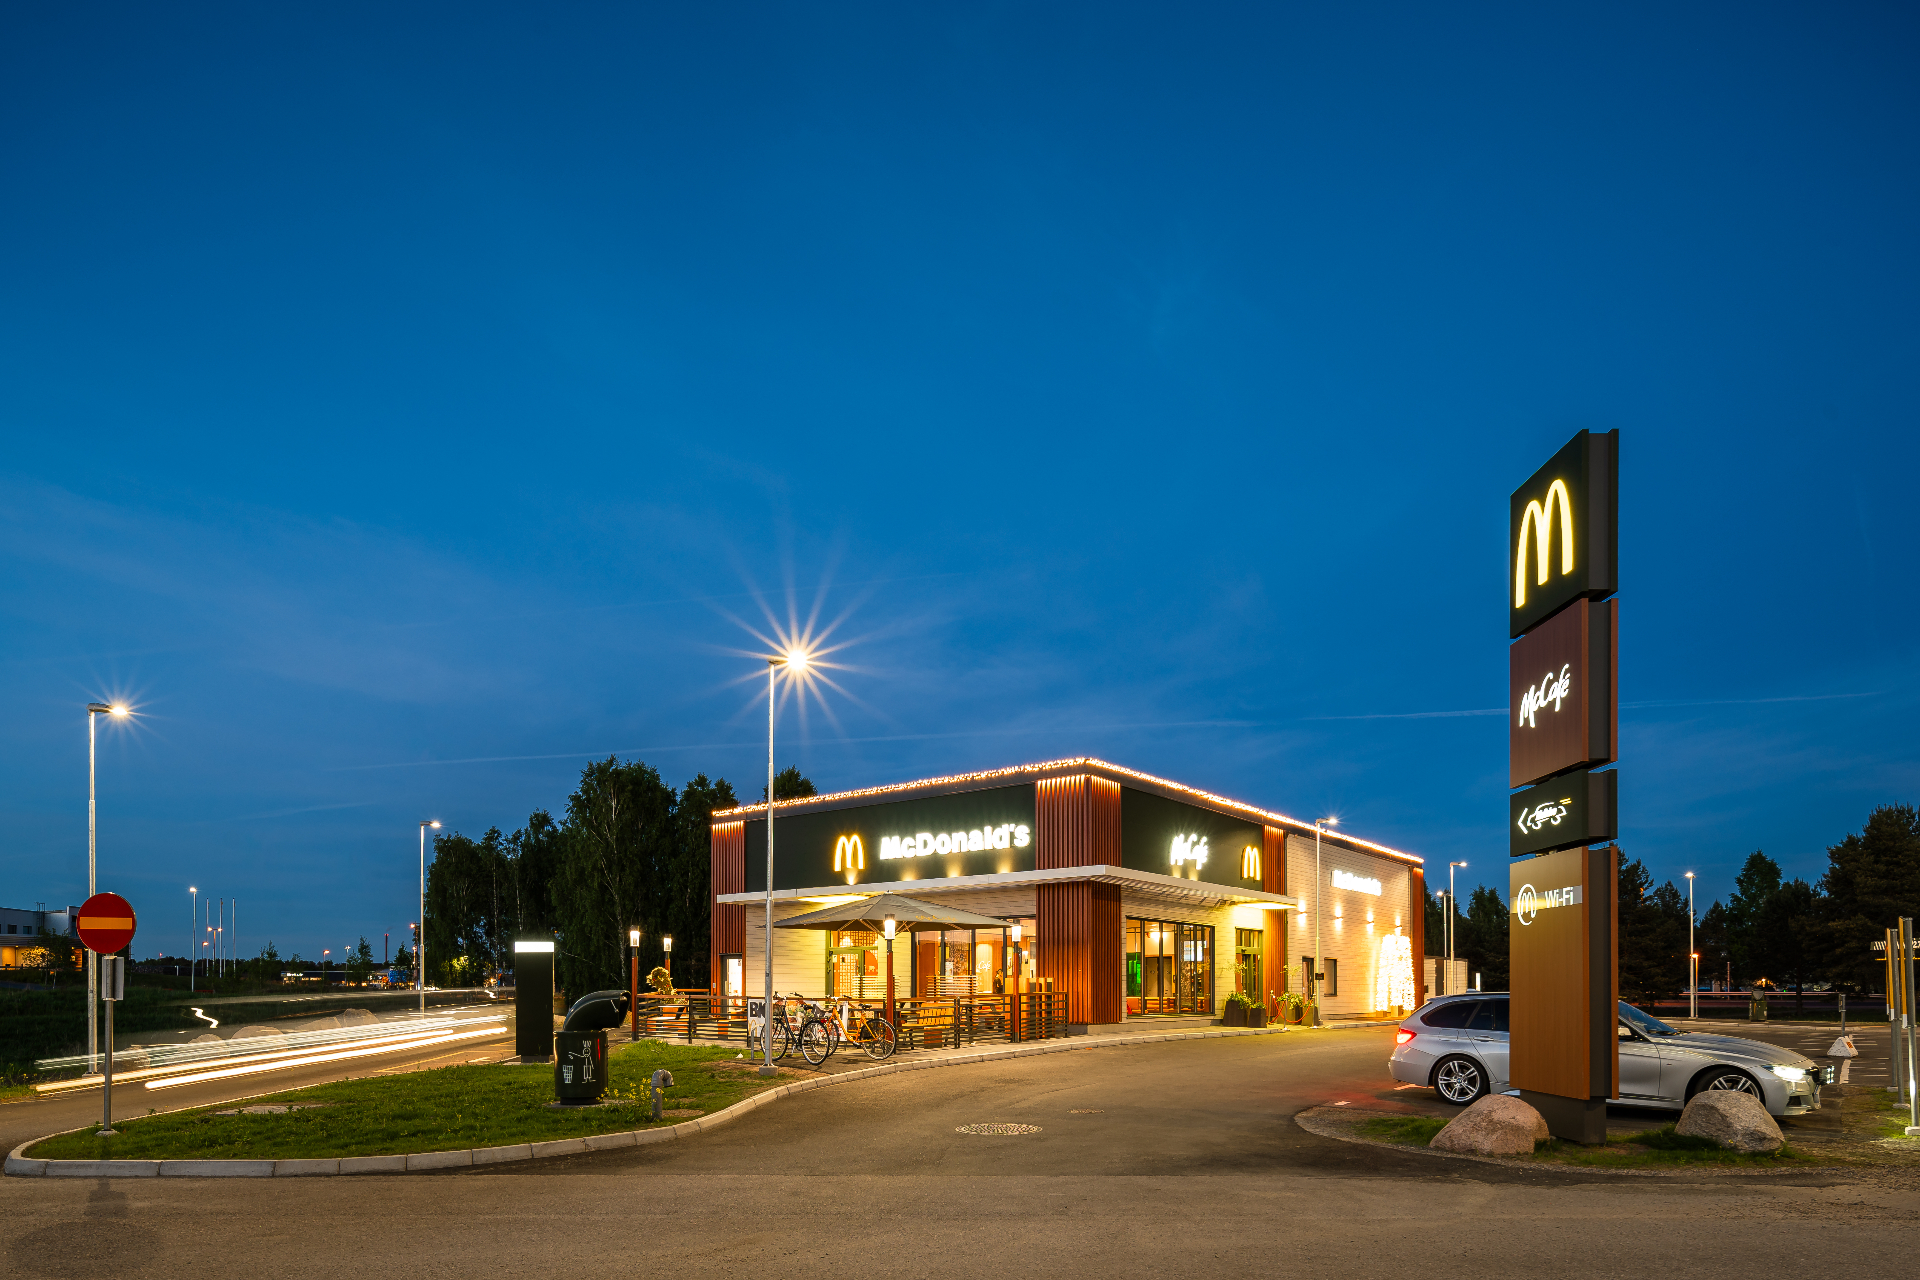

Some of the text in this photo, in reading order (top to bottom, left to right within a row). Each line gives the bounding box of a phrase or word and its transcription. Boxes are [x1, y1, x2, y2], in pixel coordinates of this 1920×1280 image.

[1519, 663, 1571, 728] McCafé
[879, 823, 1030, 860] McDonald's
[1544, 886, 1573, 909] Wi-Fi
